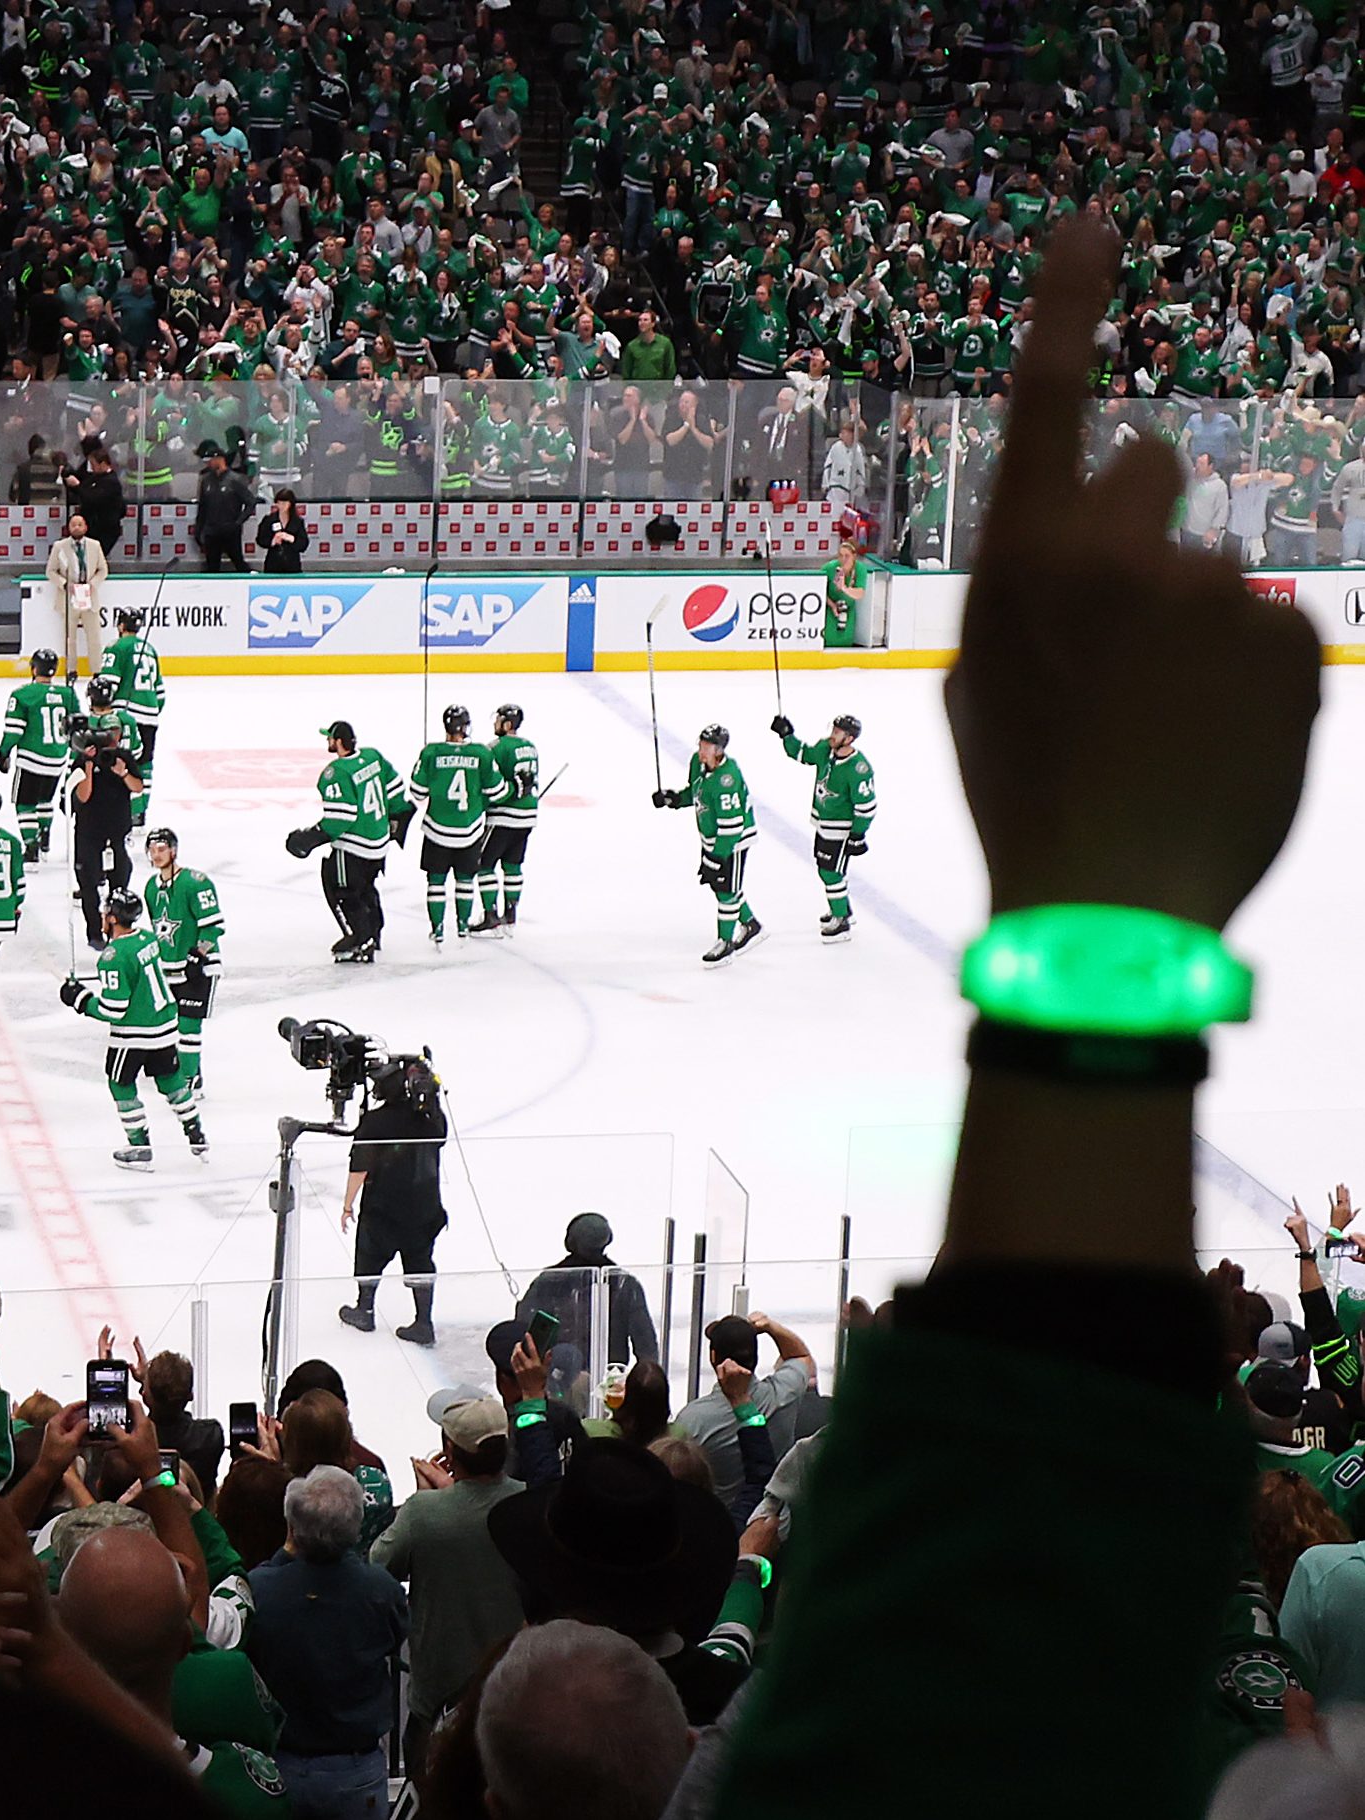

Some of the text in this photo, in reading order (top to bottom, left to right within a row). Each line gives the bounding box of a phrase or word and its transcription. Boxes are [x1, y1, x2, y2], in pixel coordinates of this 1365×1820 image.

[176, 606, 228, 628] WORK.
[249, 594, 343, 638] SAP
[421, 593, 514, 637] SAP
[748, 592, 822, 623] pep
[748, 628, 792, 639] ZERO
[435, 755, 480, 769] HEISKANEN
[325, 782, 343, 799] 41
[447, 769, 469, 812] 4
[720, 792, 741, 811] 24
[196, 888, 217, 909] 53
[100, 969, 119, 991] 16
